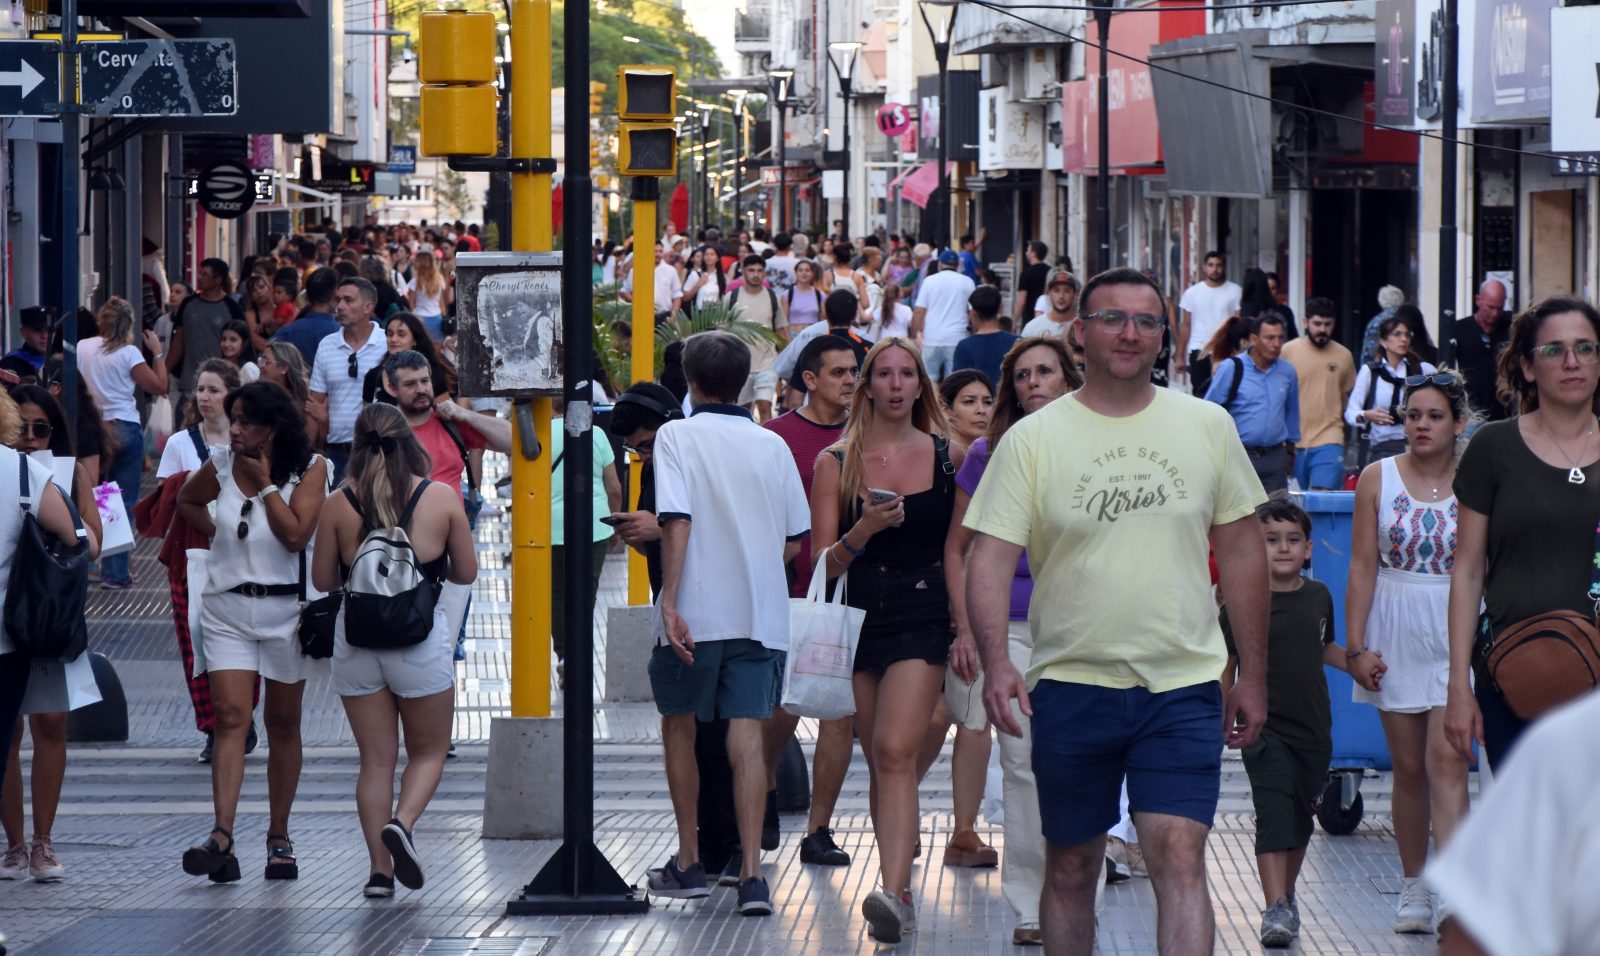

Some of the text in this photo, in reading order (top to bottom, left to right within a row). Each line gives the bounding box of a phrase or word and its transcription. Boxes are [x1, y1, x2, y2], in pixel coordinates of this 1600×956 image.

[489, 281, 520, 294] Cheryl
[1071, 446, 1188, 509] LIVE THE SEARCH
[1133, 473, 1152, 481] 1997
[1085, 483, 1170, 523] Kirios
